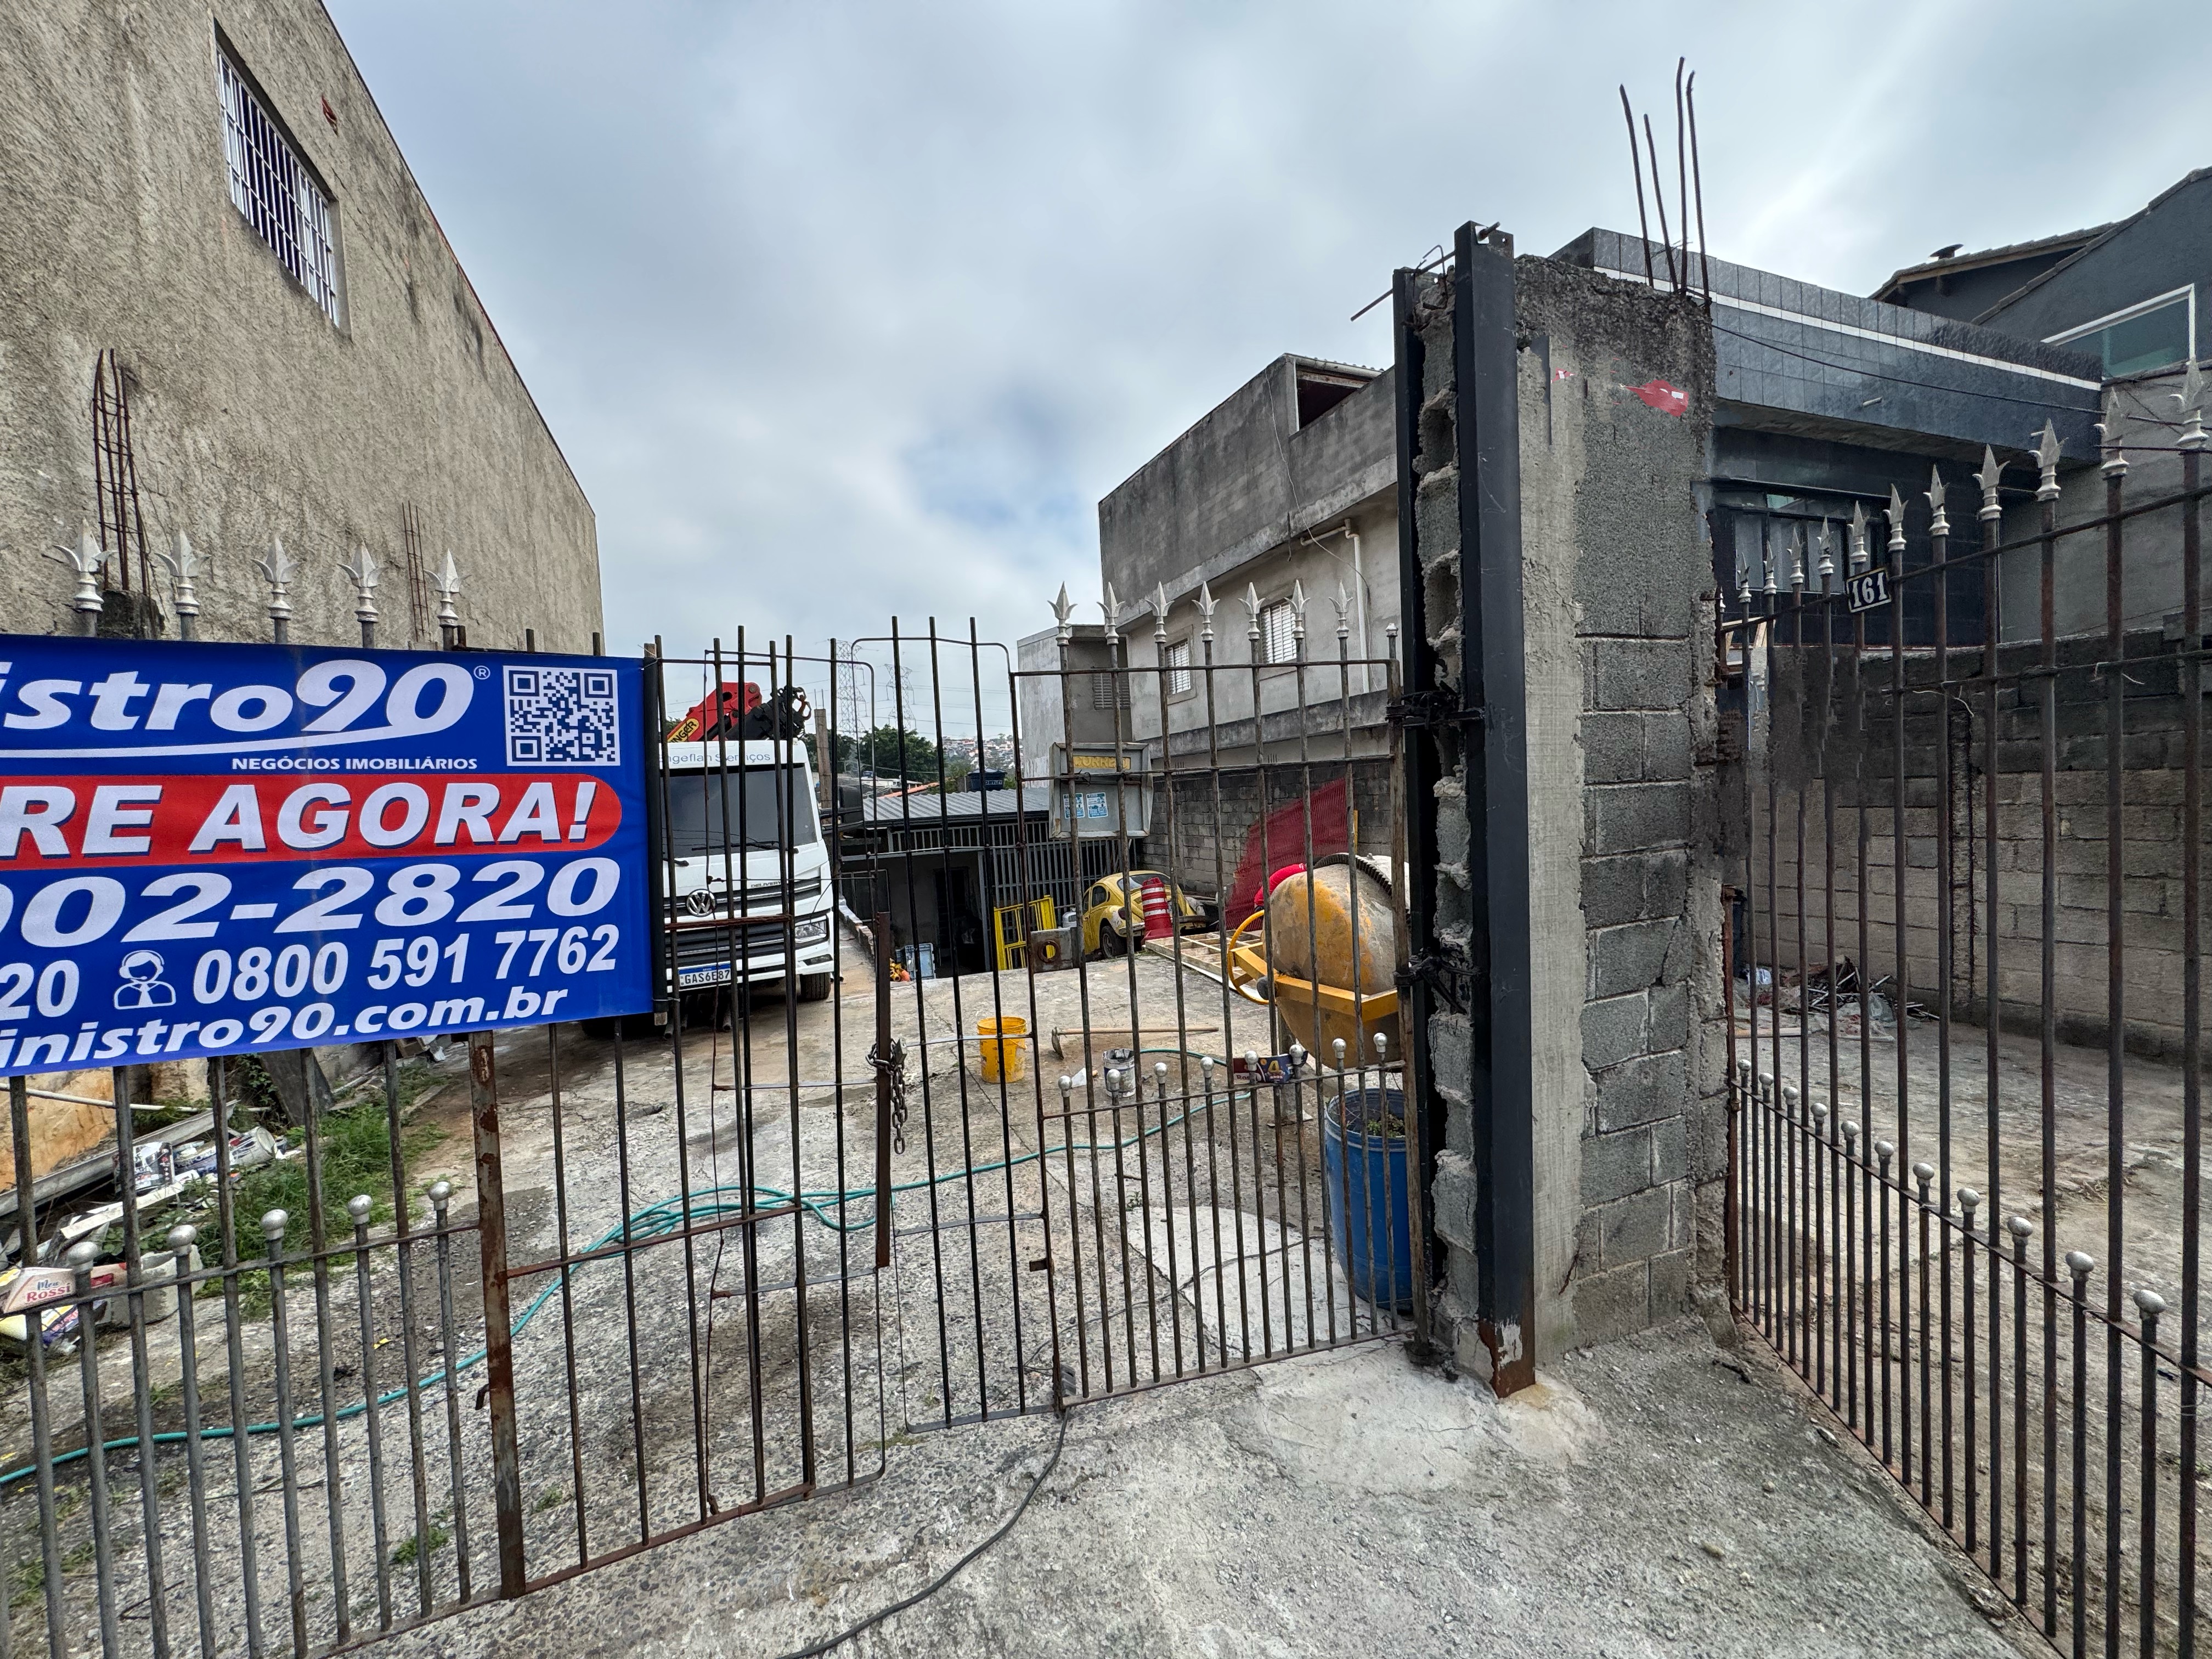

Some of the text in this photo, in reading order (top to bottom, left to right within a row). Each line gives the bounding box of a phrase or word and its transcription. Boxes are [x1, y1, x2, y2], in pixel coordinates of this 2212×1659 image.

[1852, 572, 1888, 608] 161
[232, 755, 478, 770] NEGÓCIOS IMOBILIÁRIOS
[715, 753, 771, 763] Seriços
[0, 782, 596, 856] RE AGORA!
[0, 857, 620, 947] 02-2820
[194, 924, 619, 1004] 0800 591 7762
[685, 969, 730, 984] GAS6E87
[0, 960, 80, 1021] 20
